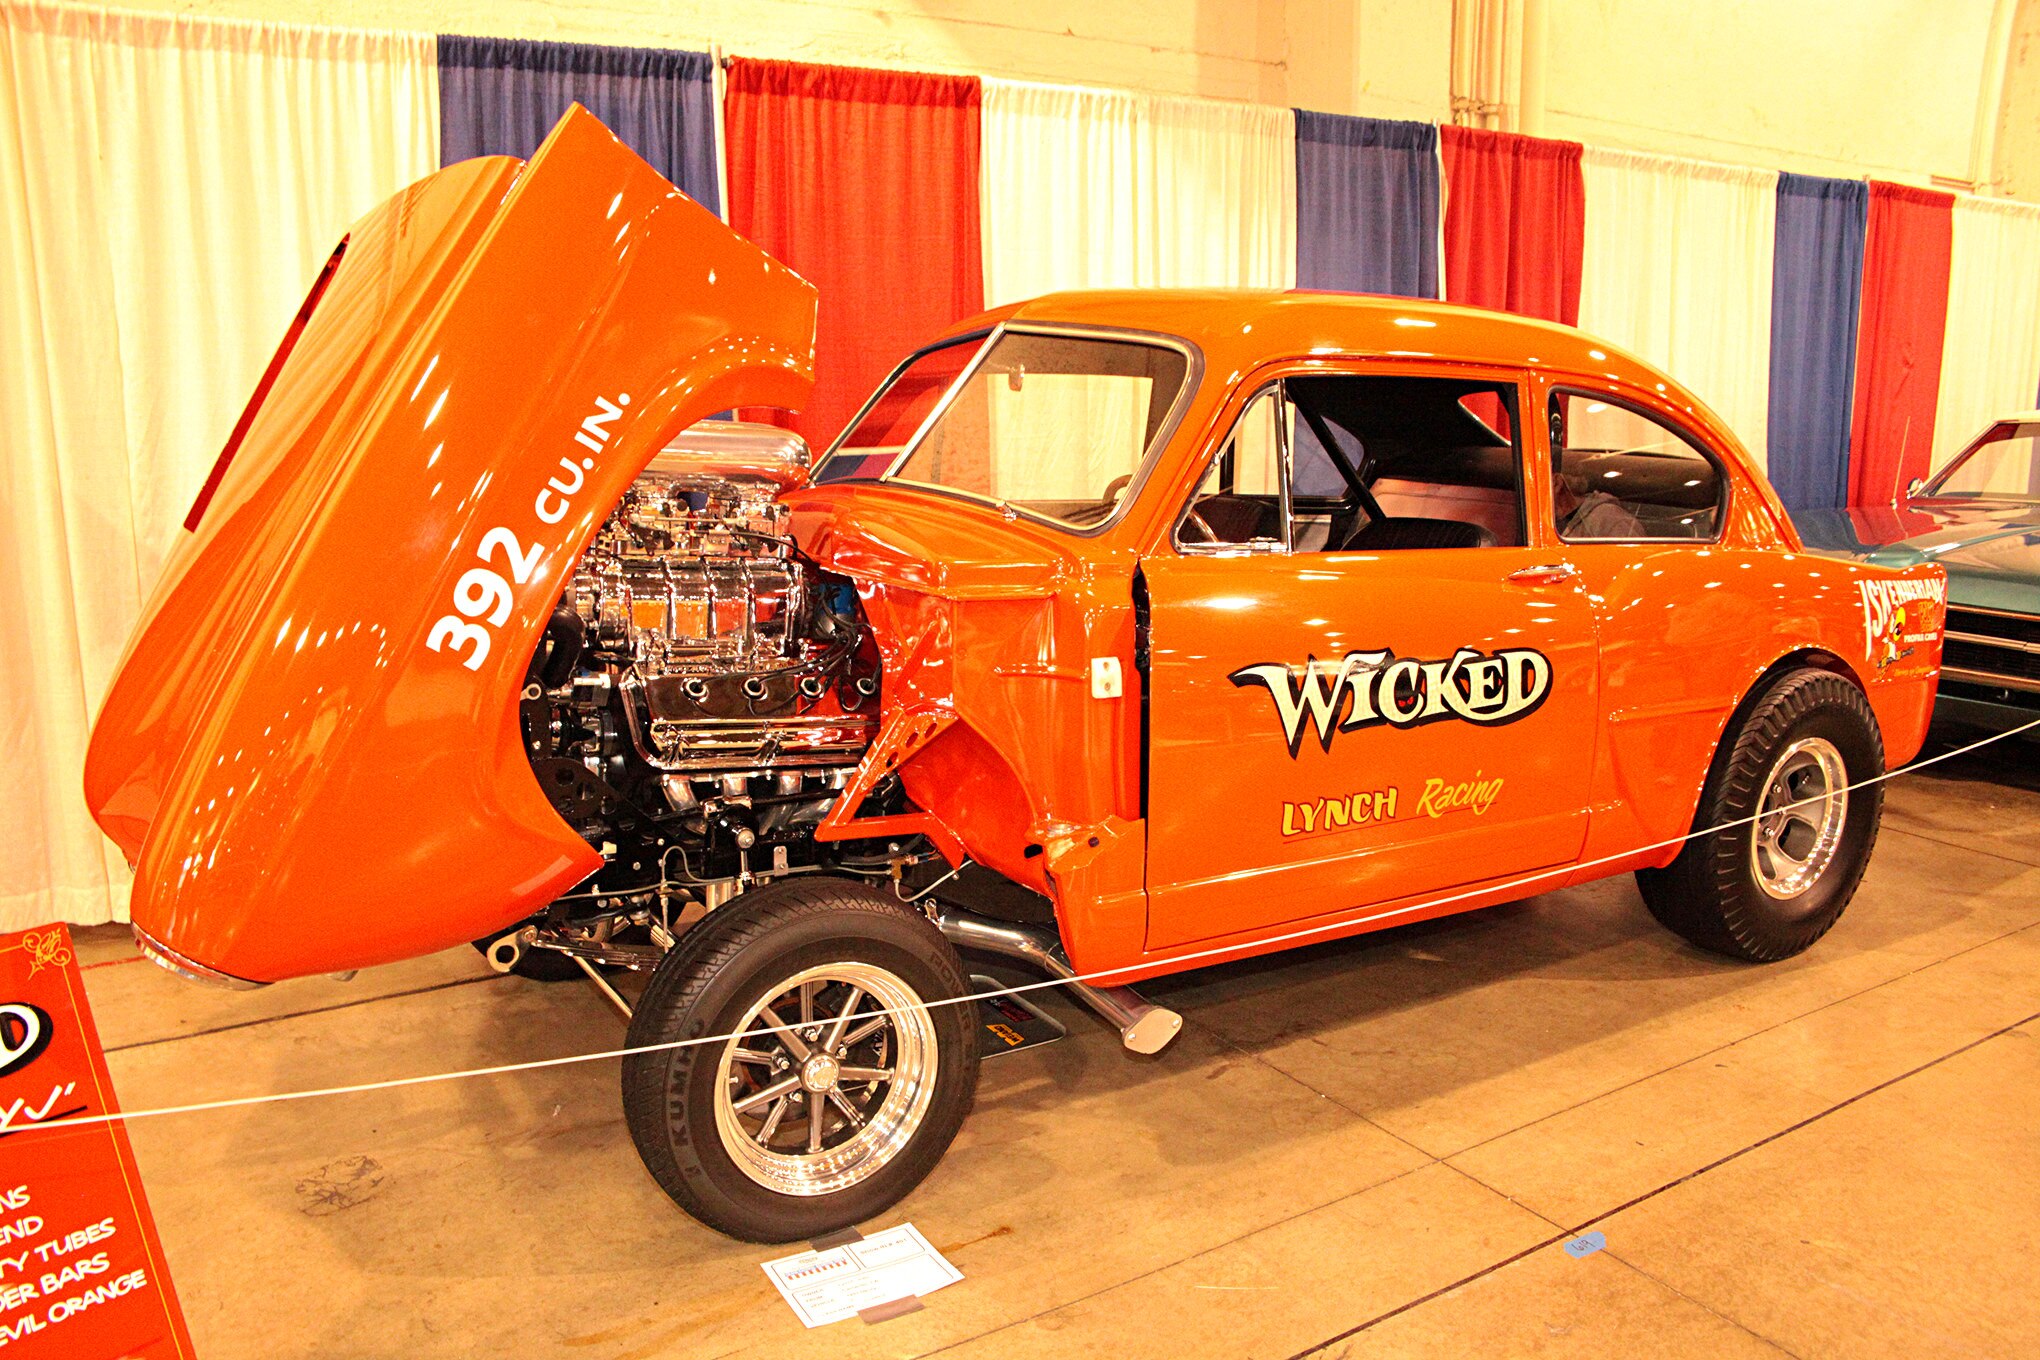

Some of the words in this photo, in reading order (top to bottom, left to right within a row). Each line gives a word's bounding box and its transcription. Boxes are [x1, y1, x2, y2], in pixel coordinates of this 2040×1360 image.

[426, 526, 545, 671] 392
[1226, 647, 1553, 761] WICKED
[1280, 786, 1399, 837] LYNCH
[1416, 769, 1504, 819] Racing
[34, 1216, 117, 1263] TUBES
[39, 1251, 110, 1295] BARS
[48, 1268, 148, 1323] ORANGE
